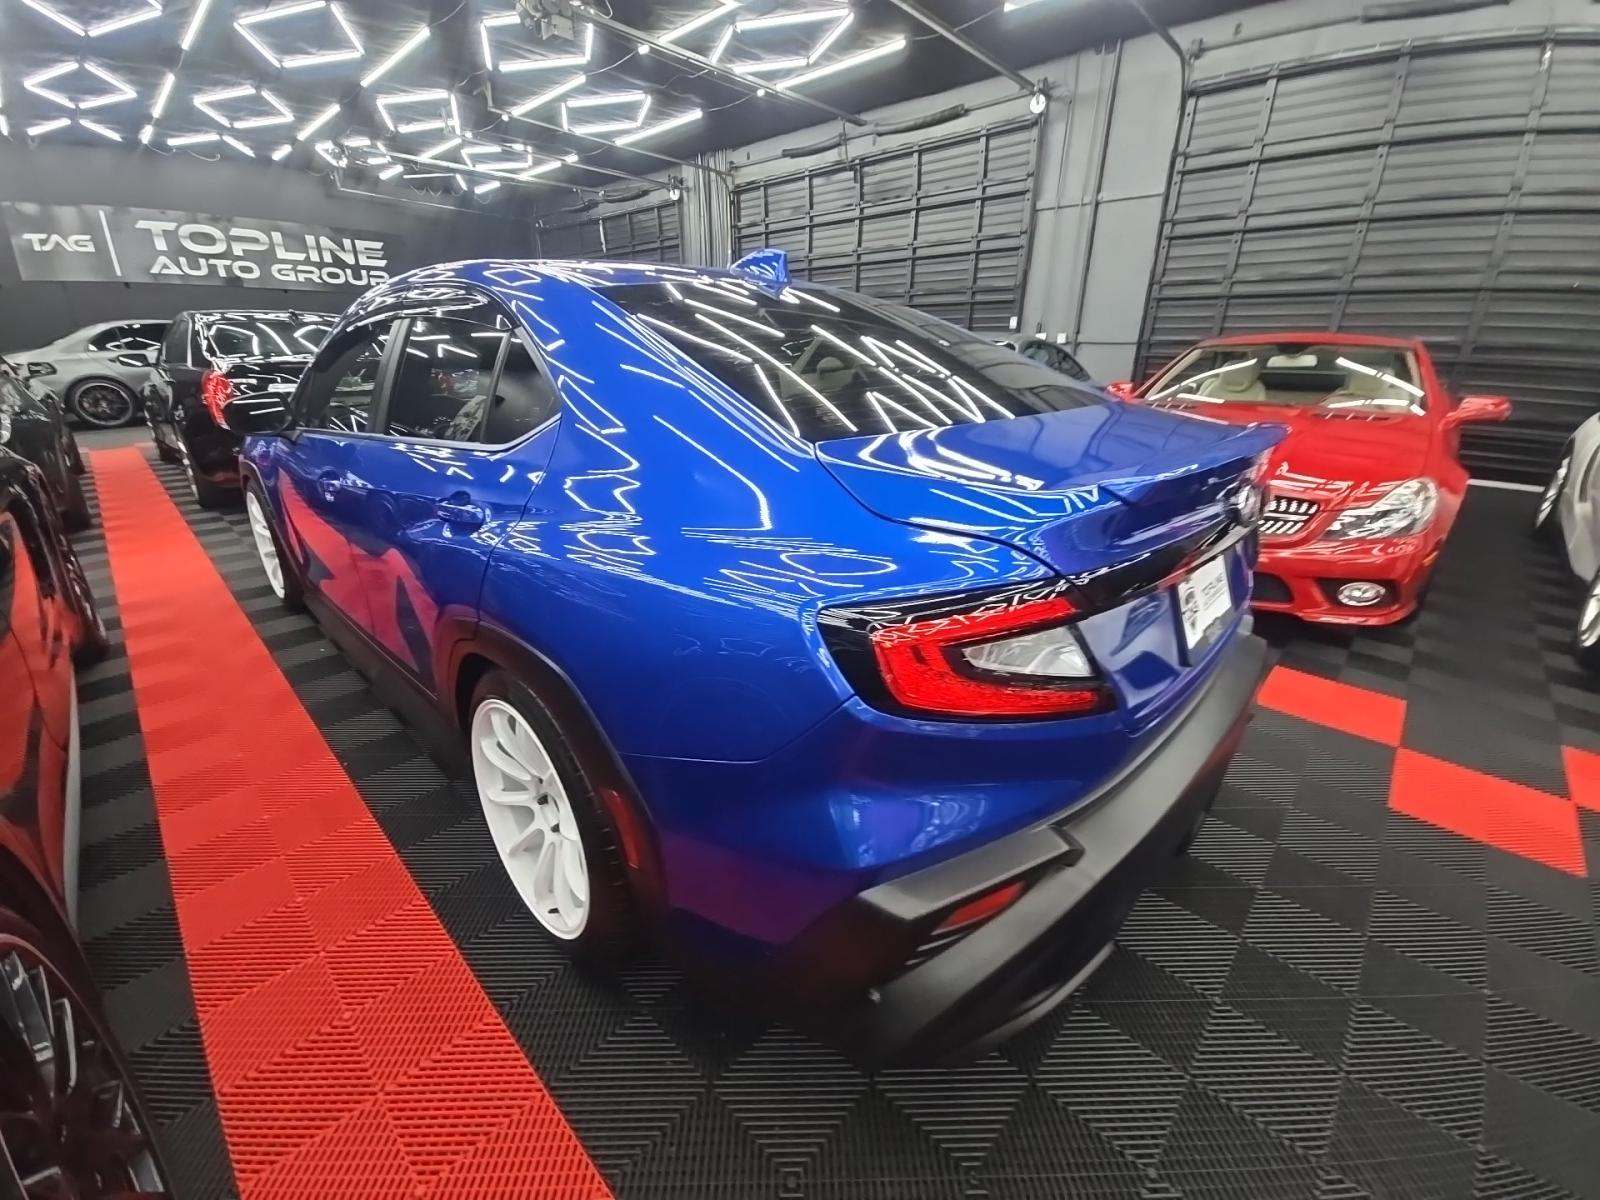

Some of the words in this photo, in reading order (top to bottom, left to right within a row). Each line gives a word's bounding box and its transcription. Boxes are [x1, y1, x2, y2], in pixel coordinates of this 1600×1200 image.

[22, 233, 96, 252] TAG
[135, 220, 388, 267] TOPLINE
[149, 255, 261, 279] AUTO
[271, 263, 390, 287] GROUP
